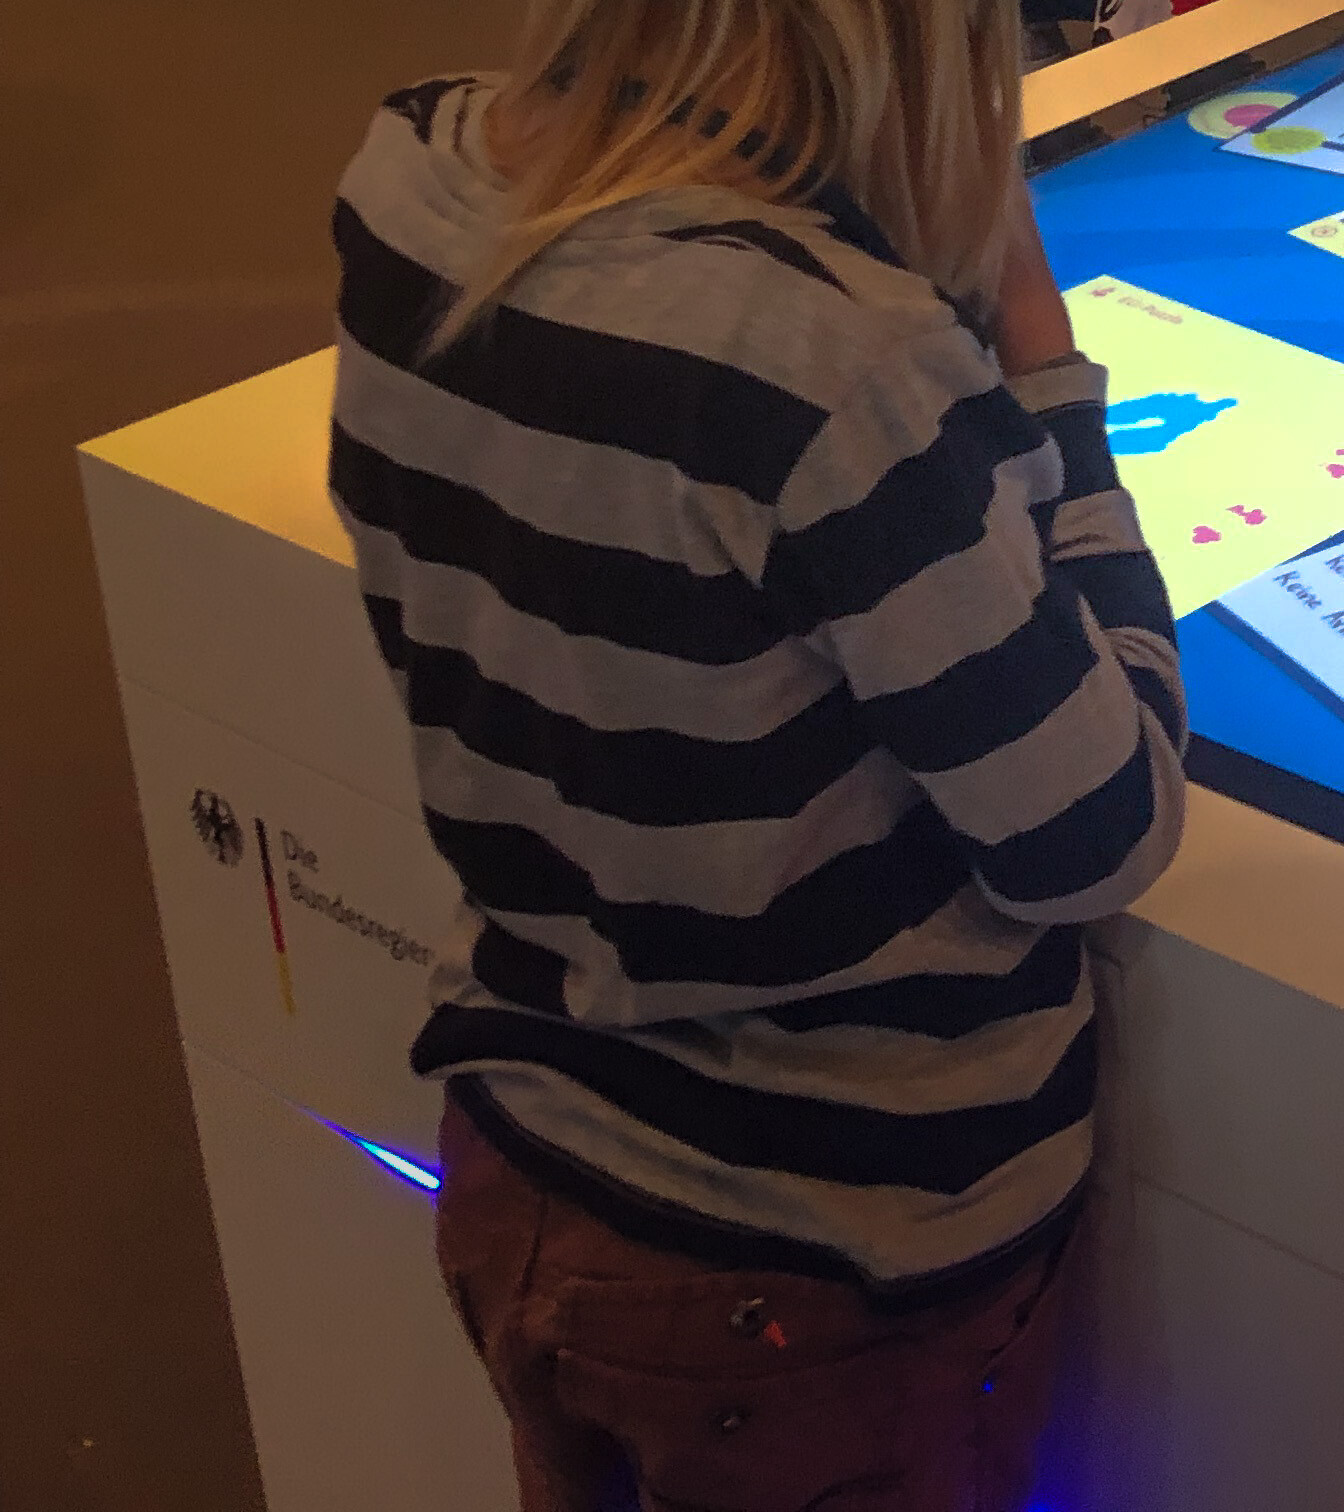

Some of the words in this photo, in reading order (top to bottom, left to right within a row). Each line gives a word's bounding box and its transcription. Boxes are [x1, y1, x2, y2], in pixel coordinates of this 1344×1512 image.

[1274, 570, 1322, 610] Keine
[281, 829, 320, 872] Die
[286, 868, 435, 968] Bundesregier
